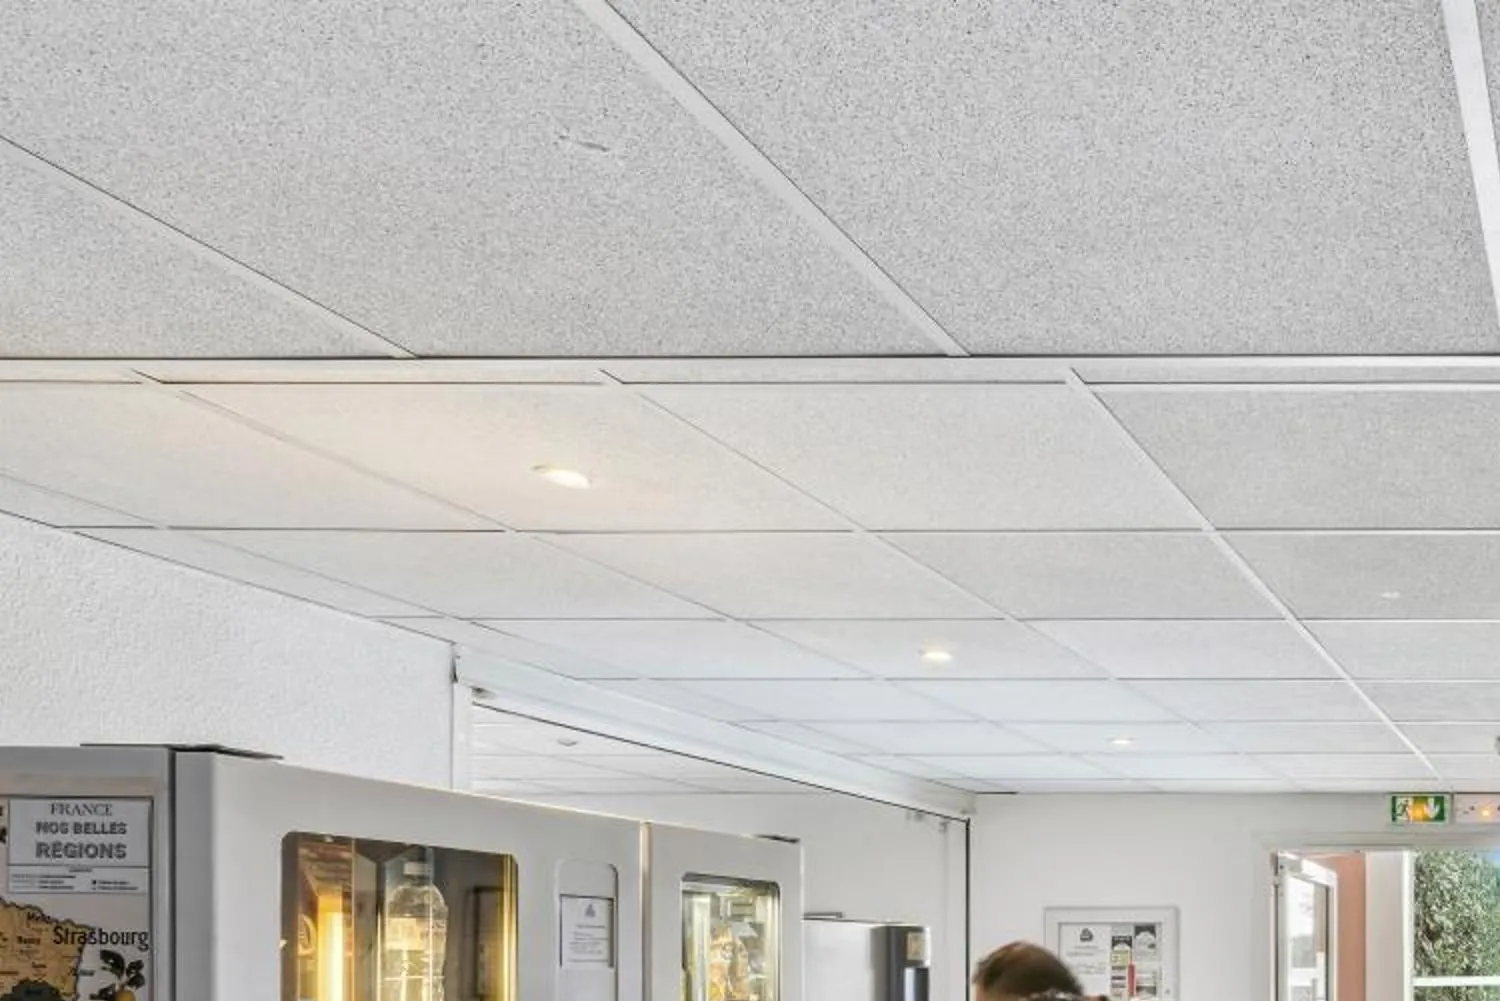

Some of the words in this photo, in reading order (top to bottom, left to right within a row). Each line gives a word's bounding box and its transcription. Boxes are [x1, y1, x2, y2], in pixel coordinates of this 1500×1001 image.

[49, 803, 113, 817] FRANCE
[35, 821, 69, 835] NOS
[73, 821, 128, 835] BELLES
[52, 925, 149, 951] Strasbourg
